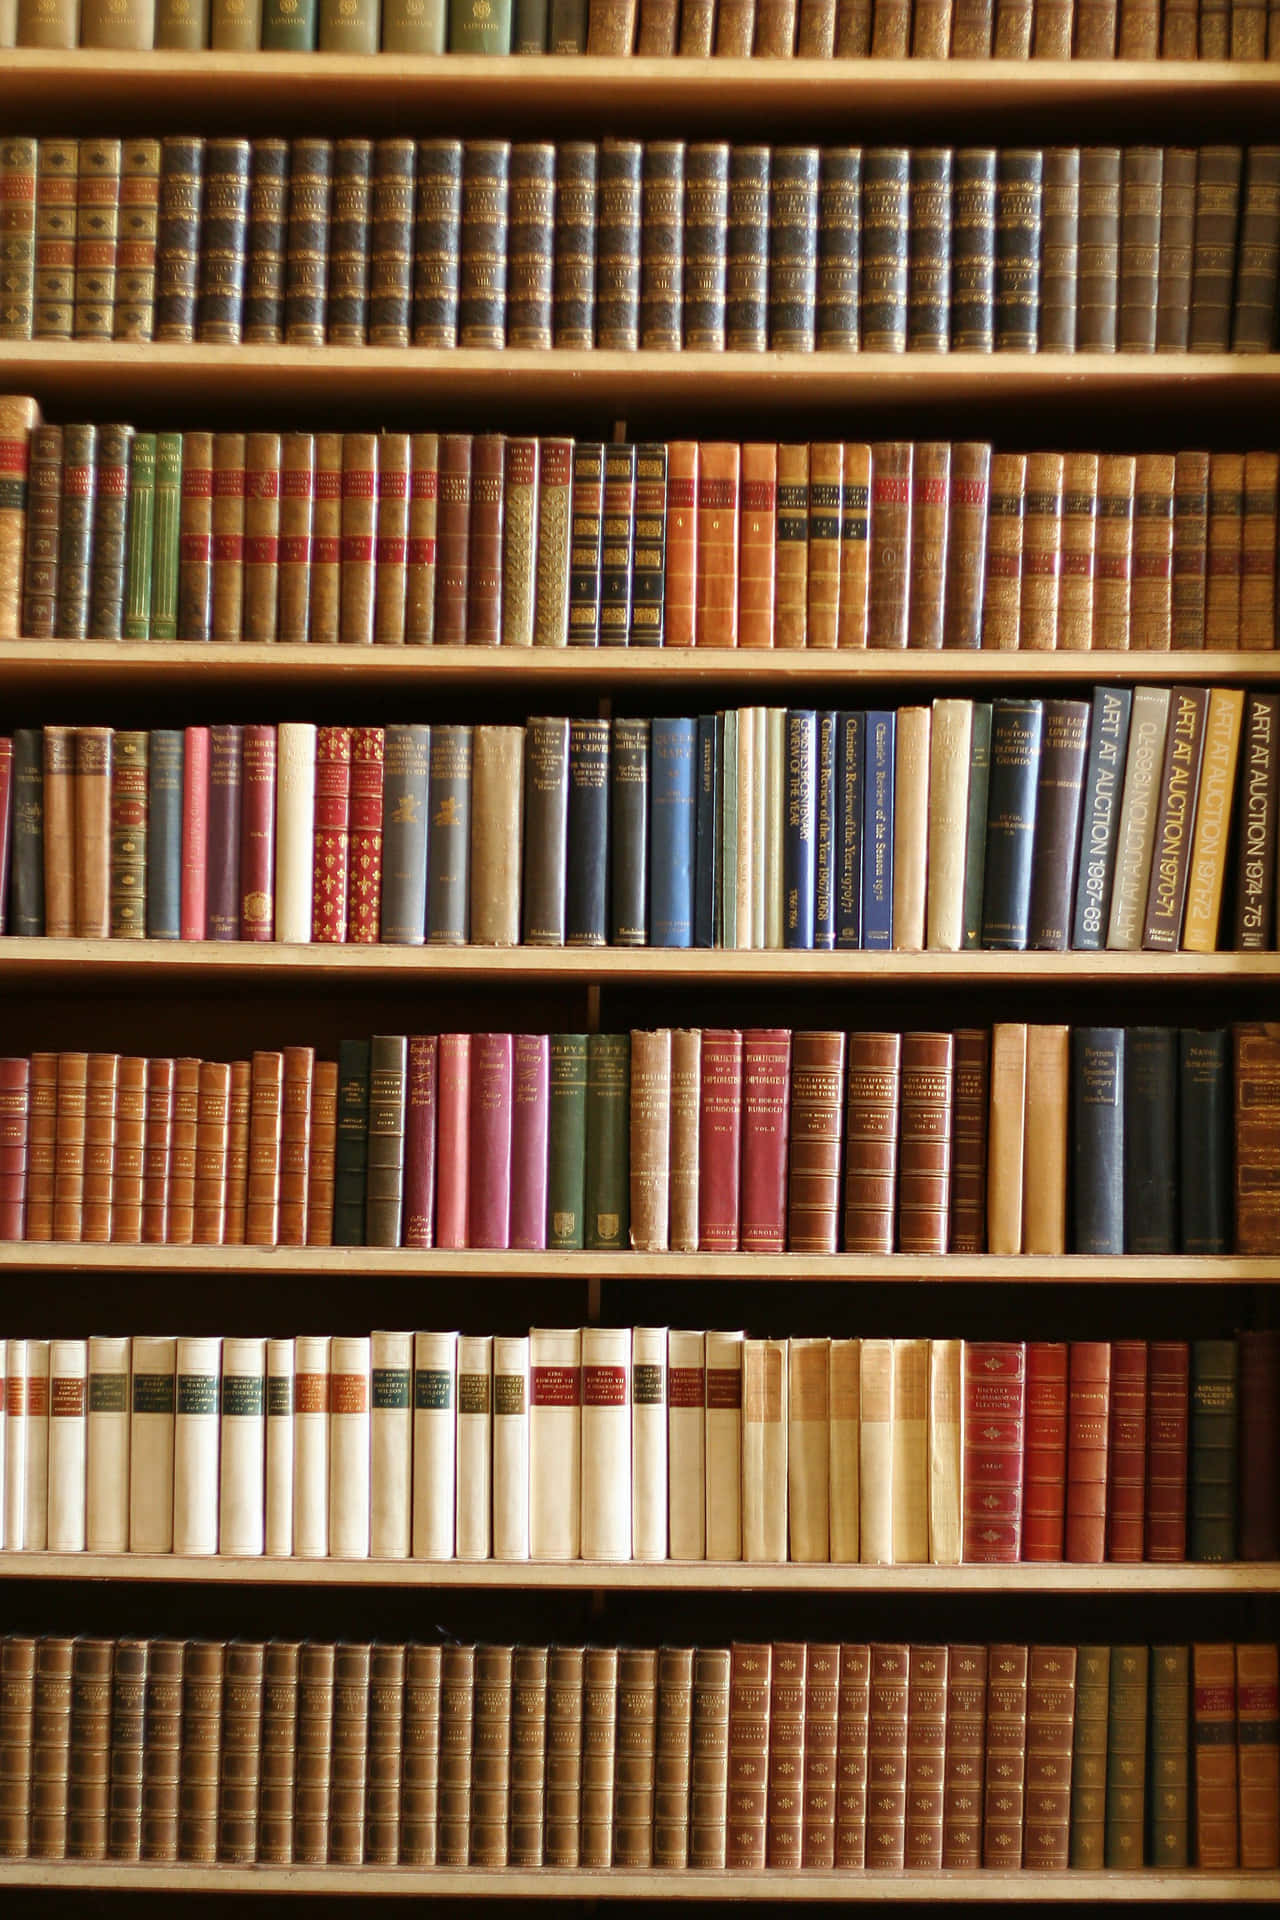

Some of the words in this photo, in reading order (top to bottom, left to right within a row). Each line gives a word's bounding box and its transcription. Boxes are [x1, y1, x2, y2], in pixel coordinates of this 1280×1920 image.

[1102, 694, 1122, 737] ART
[1176, 696, 1198, 739] ART
[1213, 698, 1235, 741] ART
[1251, 701, 1271, 743] ART
[790, 719, 800, 757] REVIEW
[845, 719, 857, 771] Christie's
[1099, 740, 1118, 765] AT
[1133, 721, 1158, 789] 1969-70
[1173, 739, 1193, 765] AT
[1210, 740, 1230, 765] AT
[1250, 745, 1270, 768] AT
[790, 778, 800, 795] THE
[820, 769, 832, 806] Review
[845, 772, 857, 811] Review
[789, 799, 800, 826] YEAR
[820, 808, 830, 821] of
[1090, 767, 1116, 855] AUCTION
[1162, 766, 1190, 855] AUCTION
[1200, 765, 1227, 854] AUCTION
[1247, 769, 1269, 856] AUCTION
[819, 822, 830, 841] the
[1124, 791, 1151, 879] AUCTION
[818, 842, 831, 865] Year
[844, 845, 856, 872] Year
[1083, 859, 1106, 932] 1967-68
[1121, 876, 1139, 901] AT
[1155, 857, 1179, 917] 1970-71
[1191, 858, 1217, 919] 1971-72
[1117, 899, 1137, 942] ART
[410, 1043, 434, 1055] English
[748, 1105, 783, 1113] RUMBOLD
